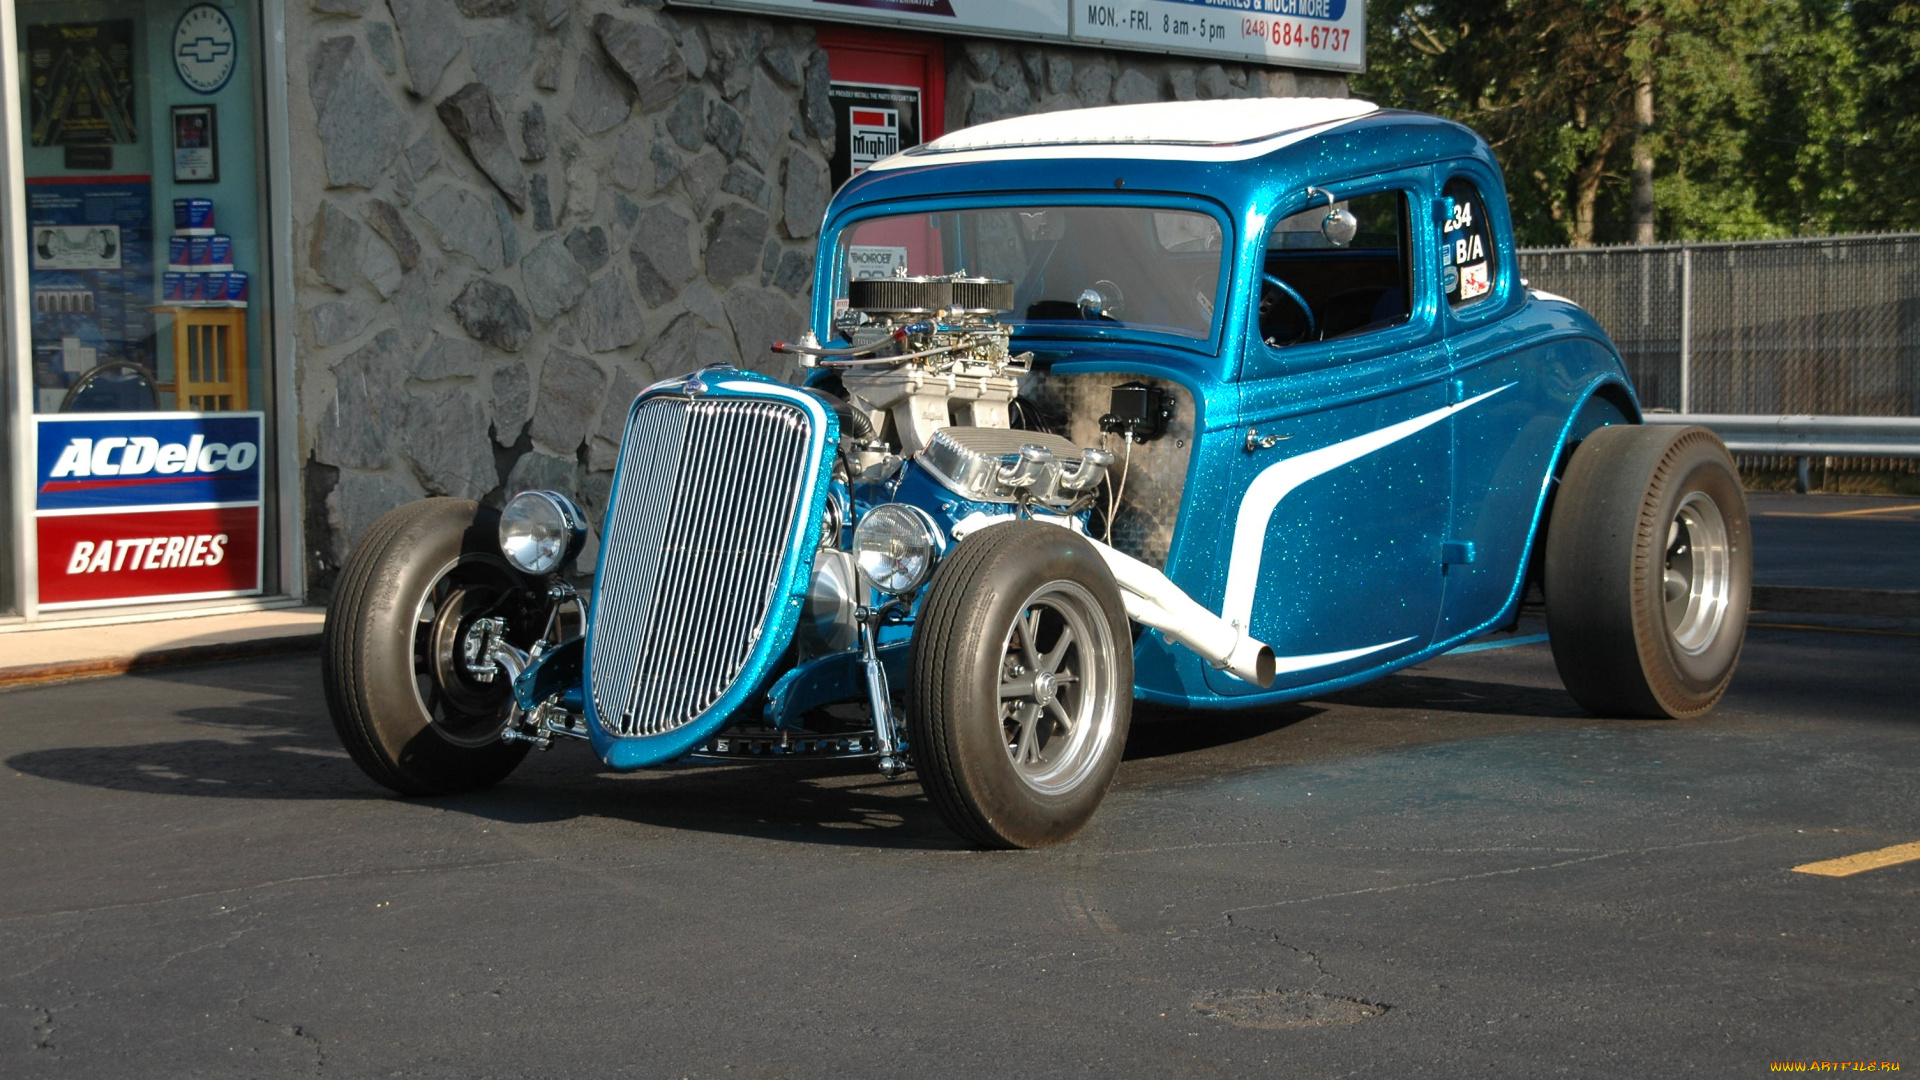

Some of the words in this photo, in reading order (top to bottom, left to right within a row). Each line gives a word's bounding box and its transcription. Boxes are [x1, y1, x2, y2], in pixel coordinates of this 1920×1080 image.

[1088, 5, 1118, 27] MON.
[1130, 10, 1152, 31] FRI.
[1163, 14, 1169, 33] 8
[1173, 20, 1189, 35] am
[1199, 19, 1206, 37] 5
[1209, 24, 1225, 42] pm
[1264, 0, 1297, 14] MUCH
[1298, 0, 1330, 18] MORE
[1241, 18, 1269, 41] (248)
[1272, 21, 1350, 52] 684-6737
[850, 252, 892, 264] MONROE
[1456, 234, 1484, 264] B/A
[50, 434, 258, 477] ACDelco
[66, 533, 229, 574] BATTERIES
